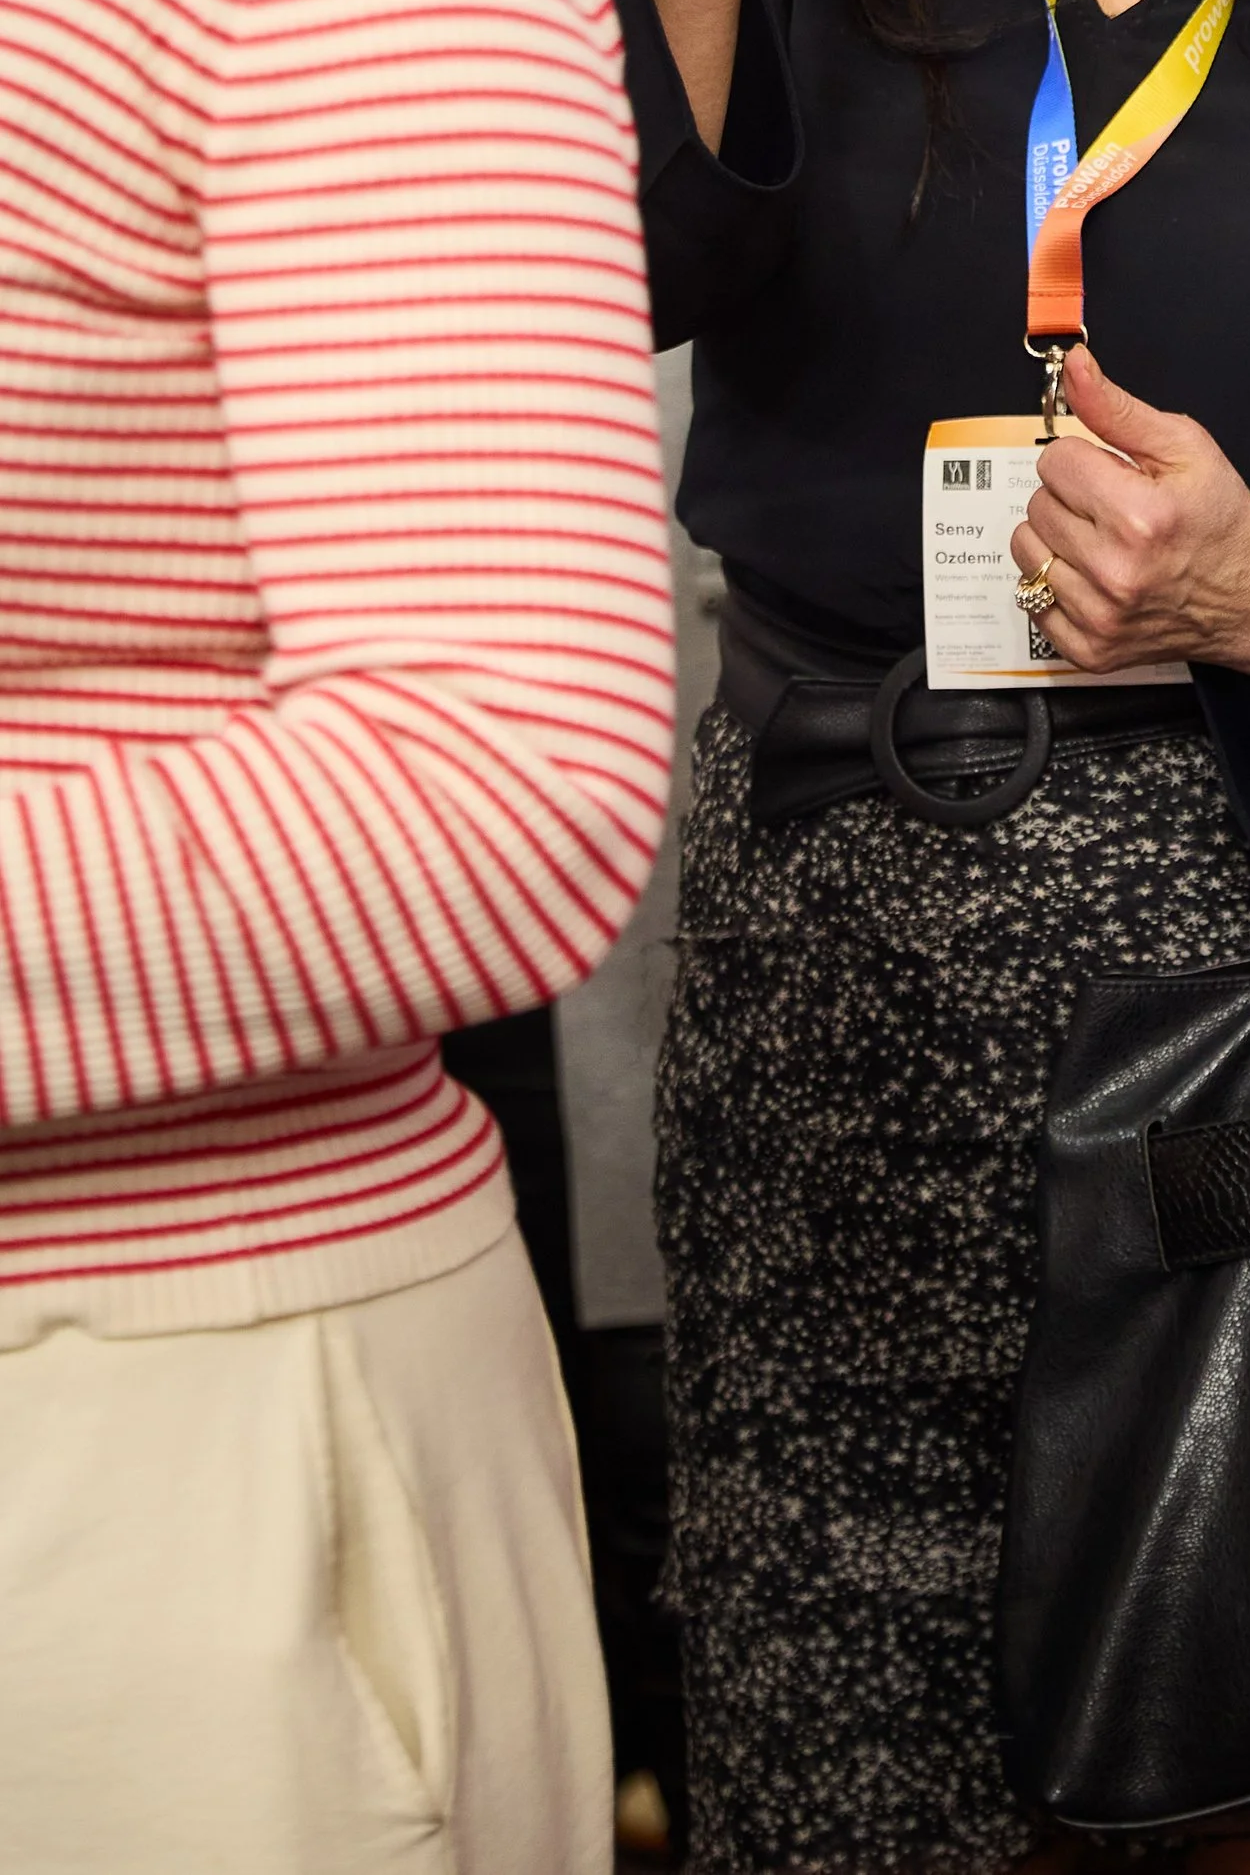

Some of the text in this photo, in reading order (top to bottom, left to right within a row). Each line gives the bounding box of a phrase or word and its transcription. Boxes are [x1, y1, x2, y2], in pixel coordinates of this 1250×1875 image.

[1054, 141, 1122, 209] ProWein
[1071, 149, 1138, 209] Düsseldorf
[1007, 477, 1043, 491] Shap
[935, 522, 984, 539] Senay
[935, 551, 1004, 564] Ozdemir
